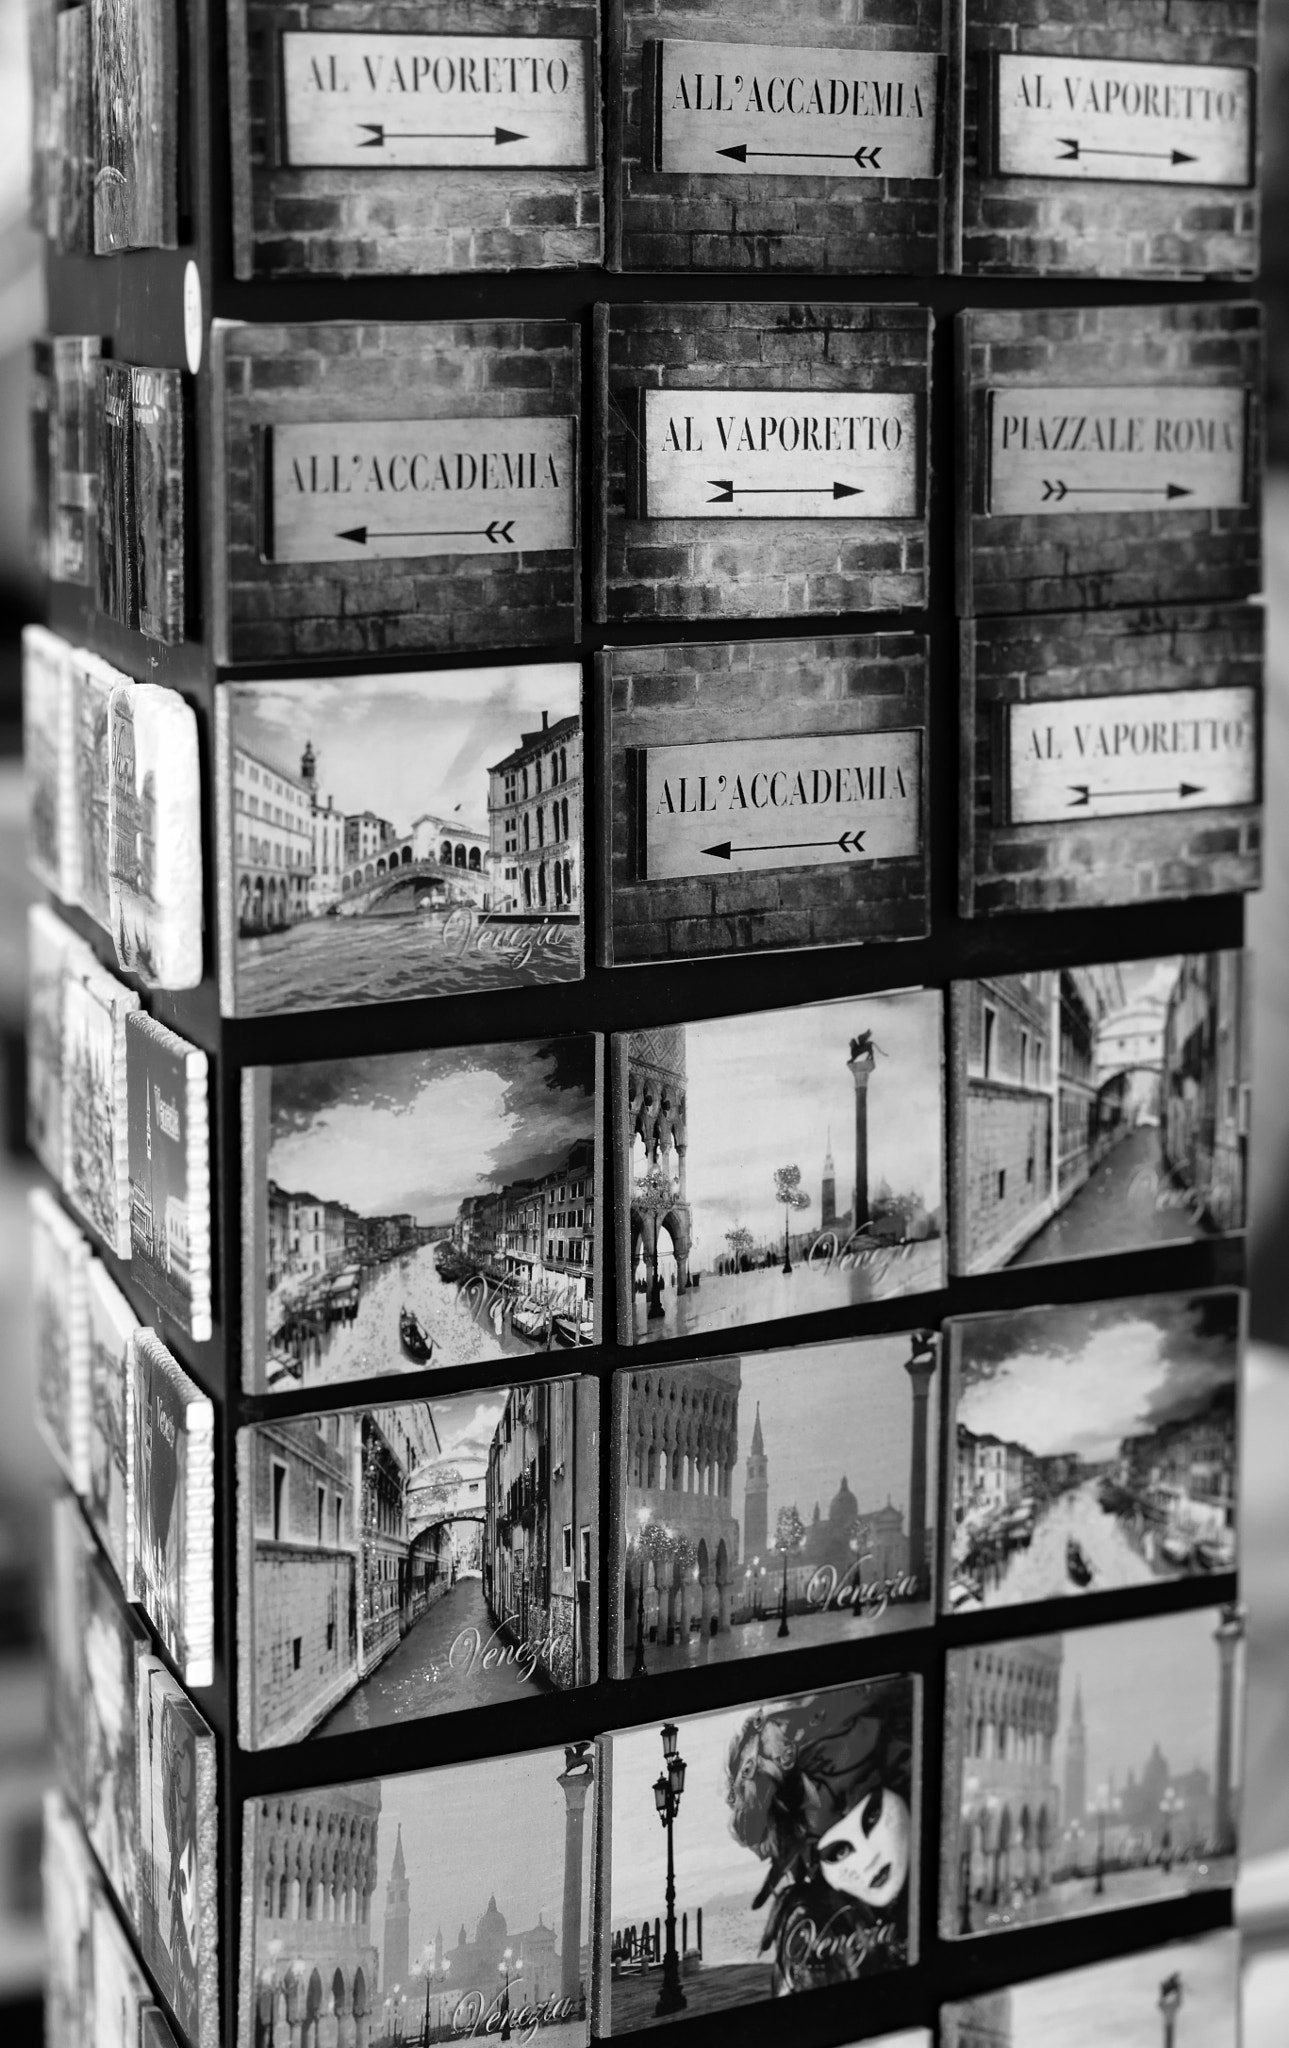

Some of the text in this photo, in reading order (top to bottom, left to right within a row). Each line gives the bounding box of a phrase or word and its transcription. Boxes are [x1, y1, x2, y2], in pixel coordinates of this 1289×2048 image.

[303, 55, 569, 94] AL VAPORETTO
[671, 73, 925, 118] ALL'ACCADEMIA
[1015, 73, 1239, 123] AL VAPORETTO
[661, 416, 902, 452] AL VAPORETTO
[1002, 416, 1235, 454] PIAZZALE ROMA
[286, 452, 561, 494] ALL'ACCADEMIA
[1025, 720, 1244, 761] AL VAPORETTO
[656, 765, 907, 815] ALL'ACCADEMIA
[443, 896, 566, 970] Venezia
[807, 1553, 917, 1622] Venezia
[449, 1614, 569, 1684] Venezia
[786, 1904, 897, 1970] Venezia
[452, 1977, 573, 2046] Venezia
